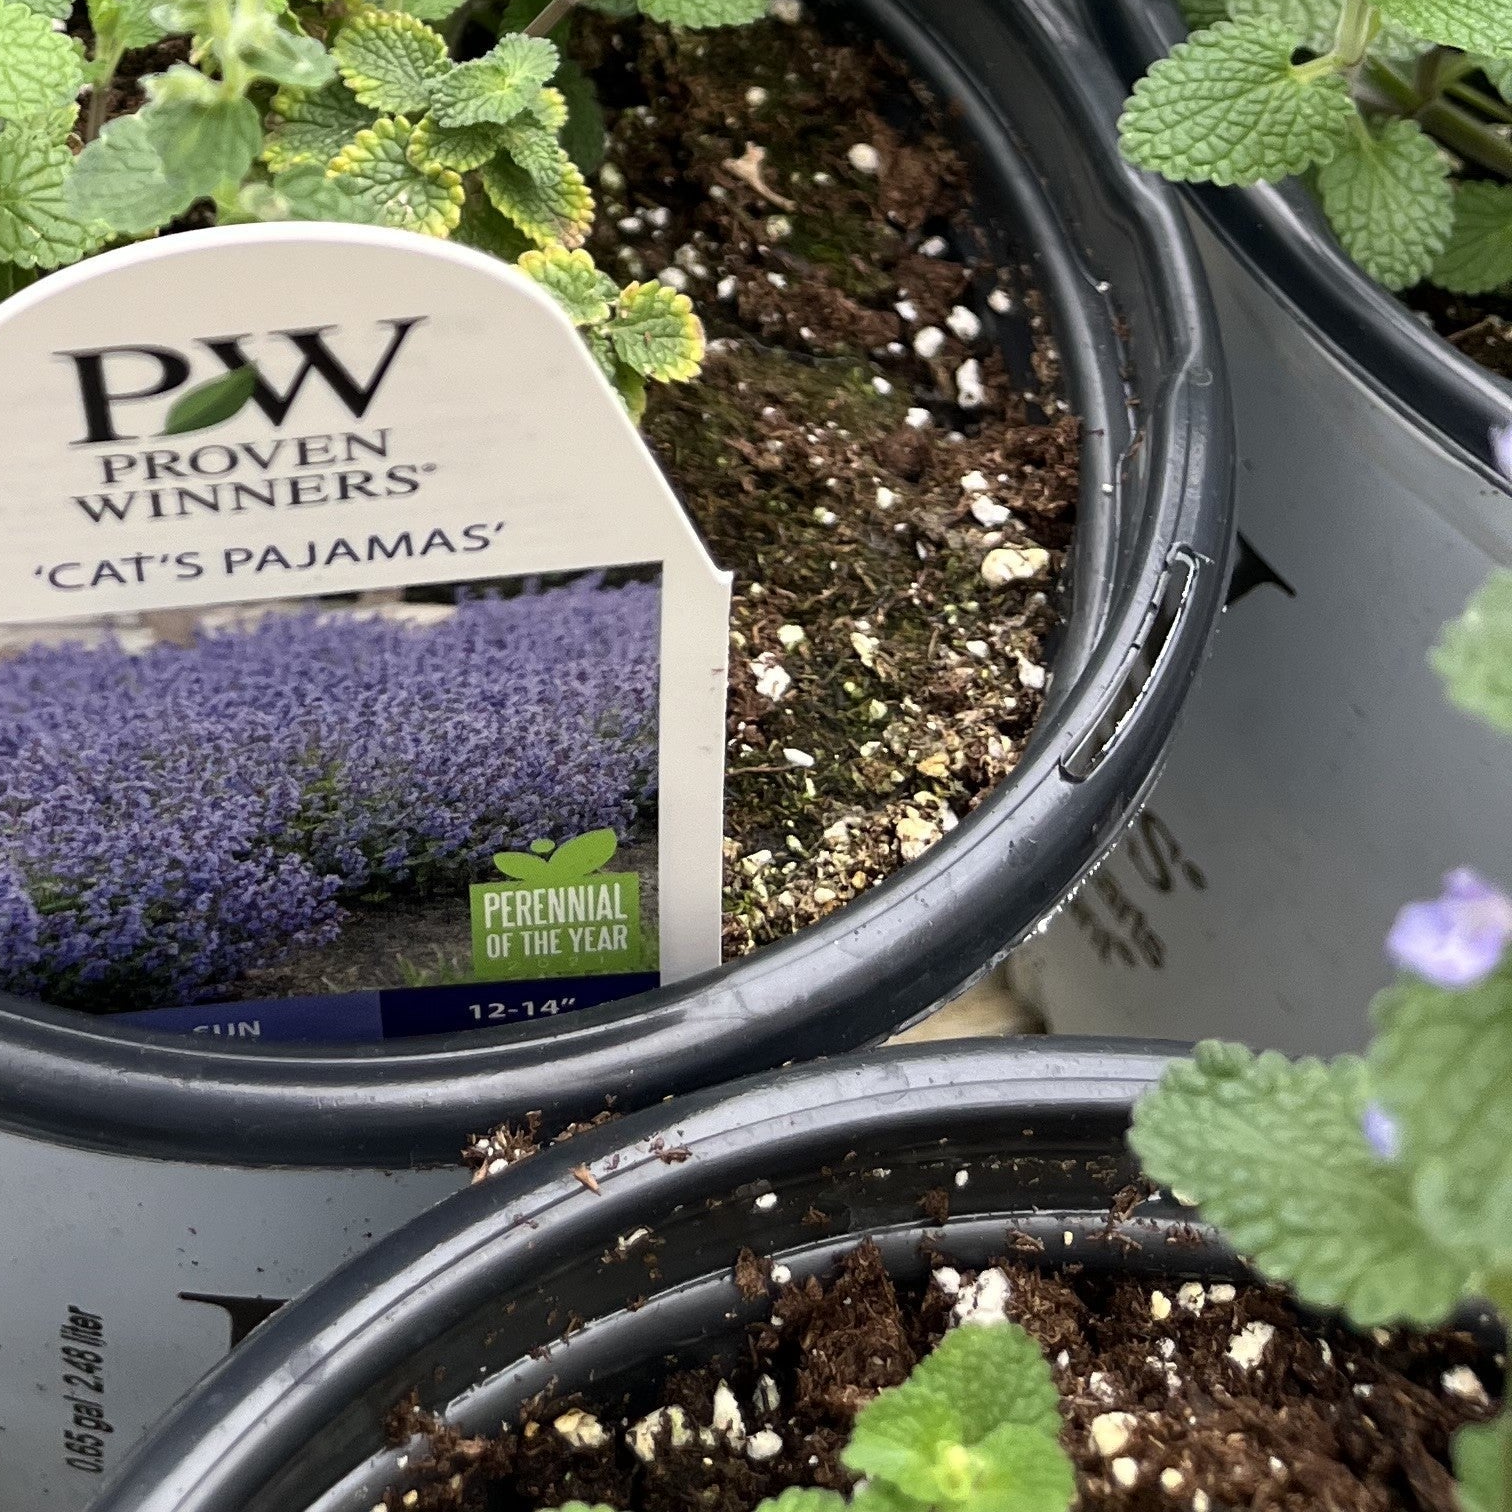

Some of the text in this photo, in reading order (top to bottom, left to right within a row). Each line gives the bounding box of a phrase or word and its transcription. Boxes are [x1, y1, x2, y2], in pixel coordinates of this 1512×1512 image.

[51, 315, 428, 446] PW
[100, 427, 393, 485] PROVEN
[32, 520, 506, 590] 'CAT'S PAJAMAS'
[483, 882, 628, 929] PERENNIAL
[486, 924, 628, 959] OF THE YEAR
[59, 1304, 114, 1474] 0.65 gal 2.48 liter
